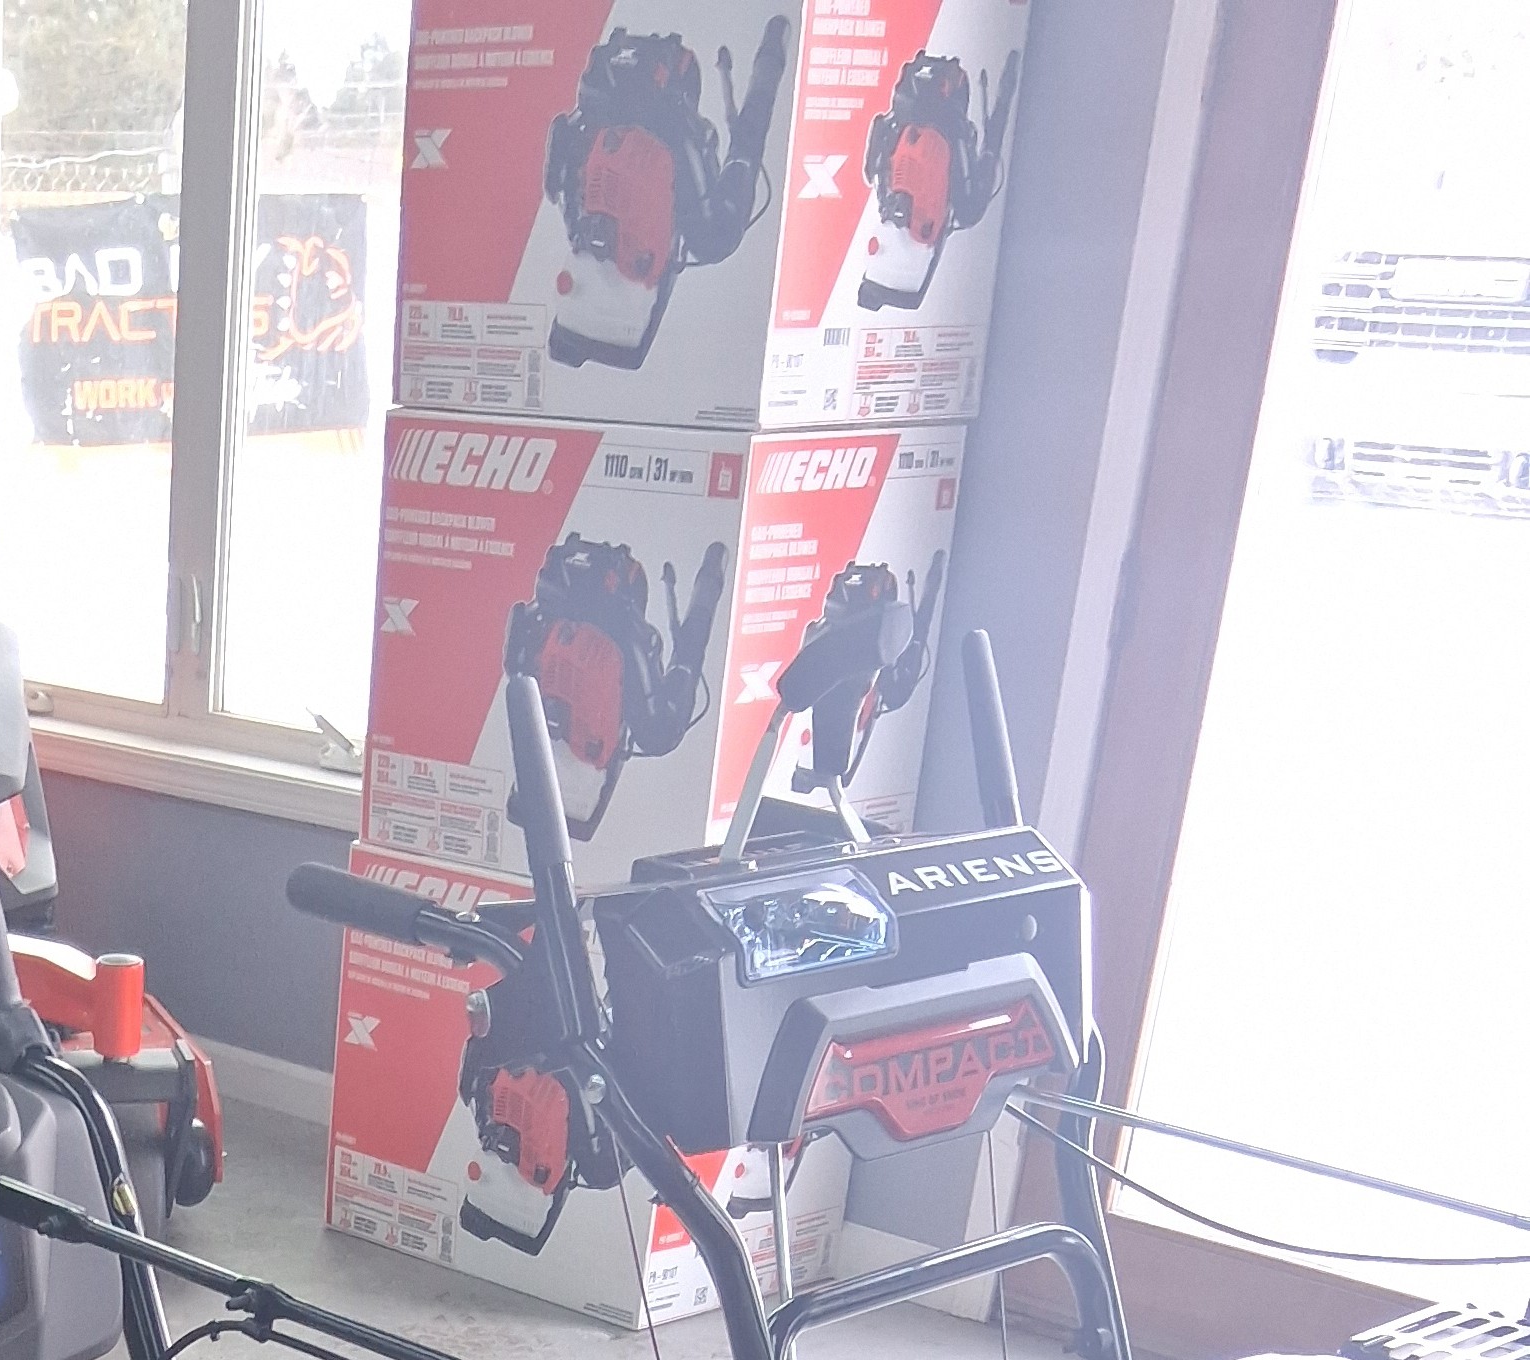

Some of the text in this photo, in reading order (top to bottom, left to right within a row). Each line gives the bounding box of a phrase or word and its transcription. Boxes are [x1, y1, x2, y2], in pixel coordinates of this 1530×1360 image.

[17, 246, 143, 296] BAD
[72, 379, 161, 409] WORK
[419, 431, 558, 494] ECHO
[653, 456, 669, 481] 31
[781, 446, 878, 492] ECHO
[888, 849, 1065, 896] ARIENS
[823, 1024, 1046, 1101] COMPACT
